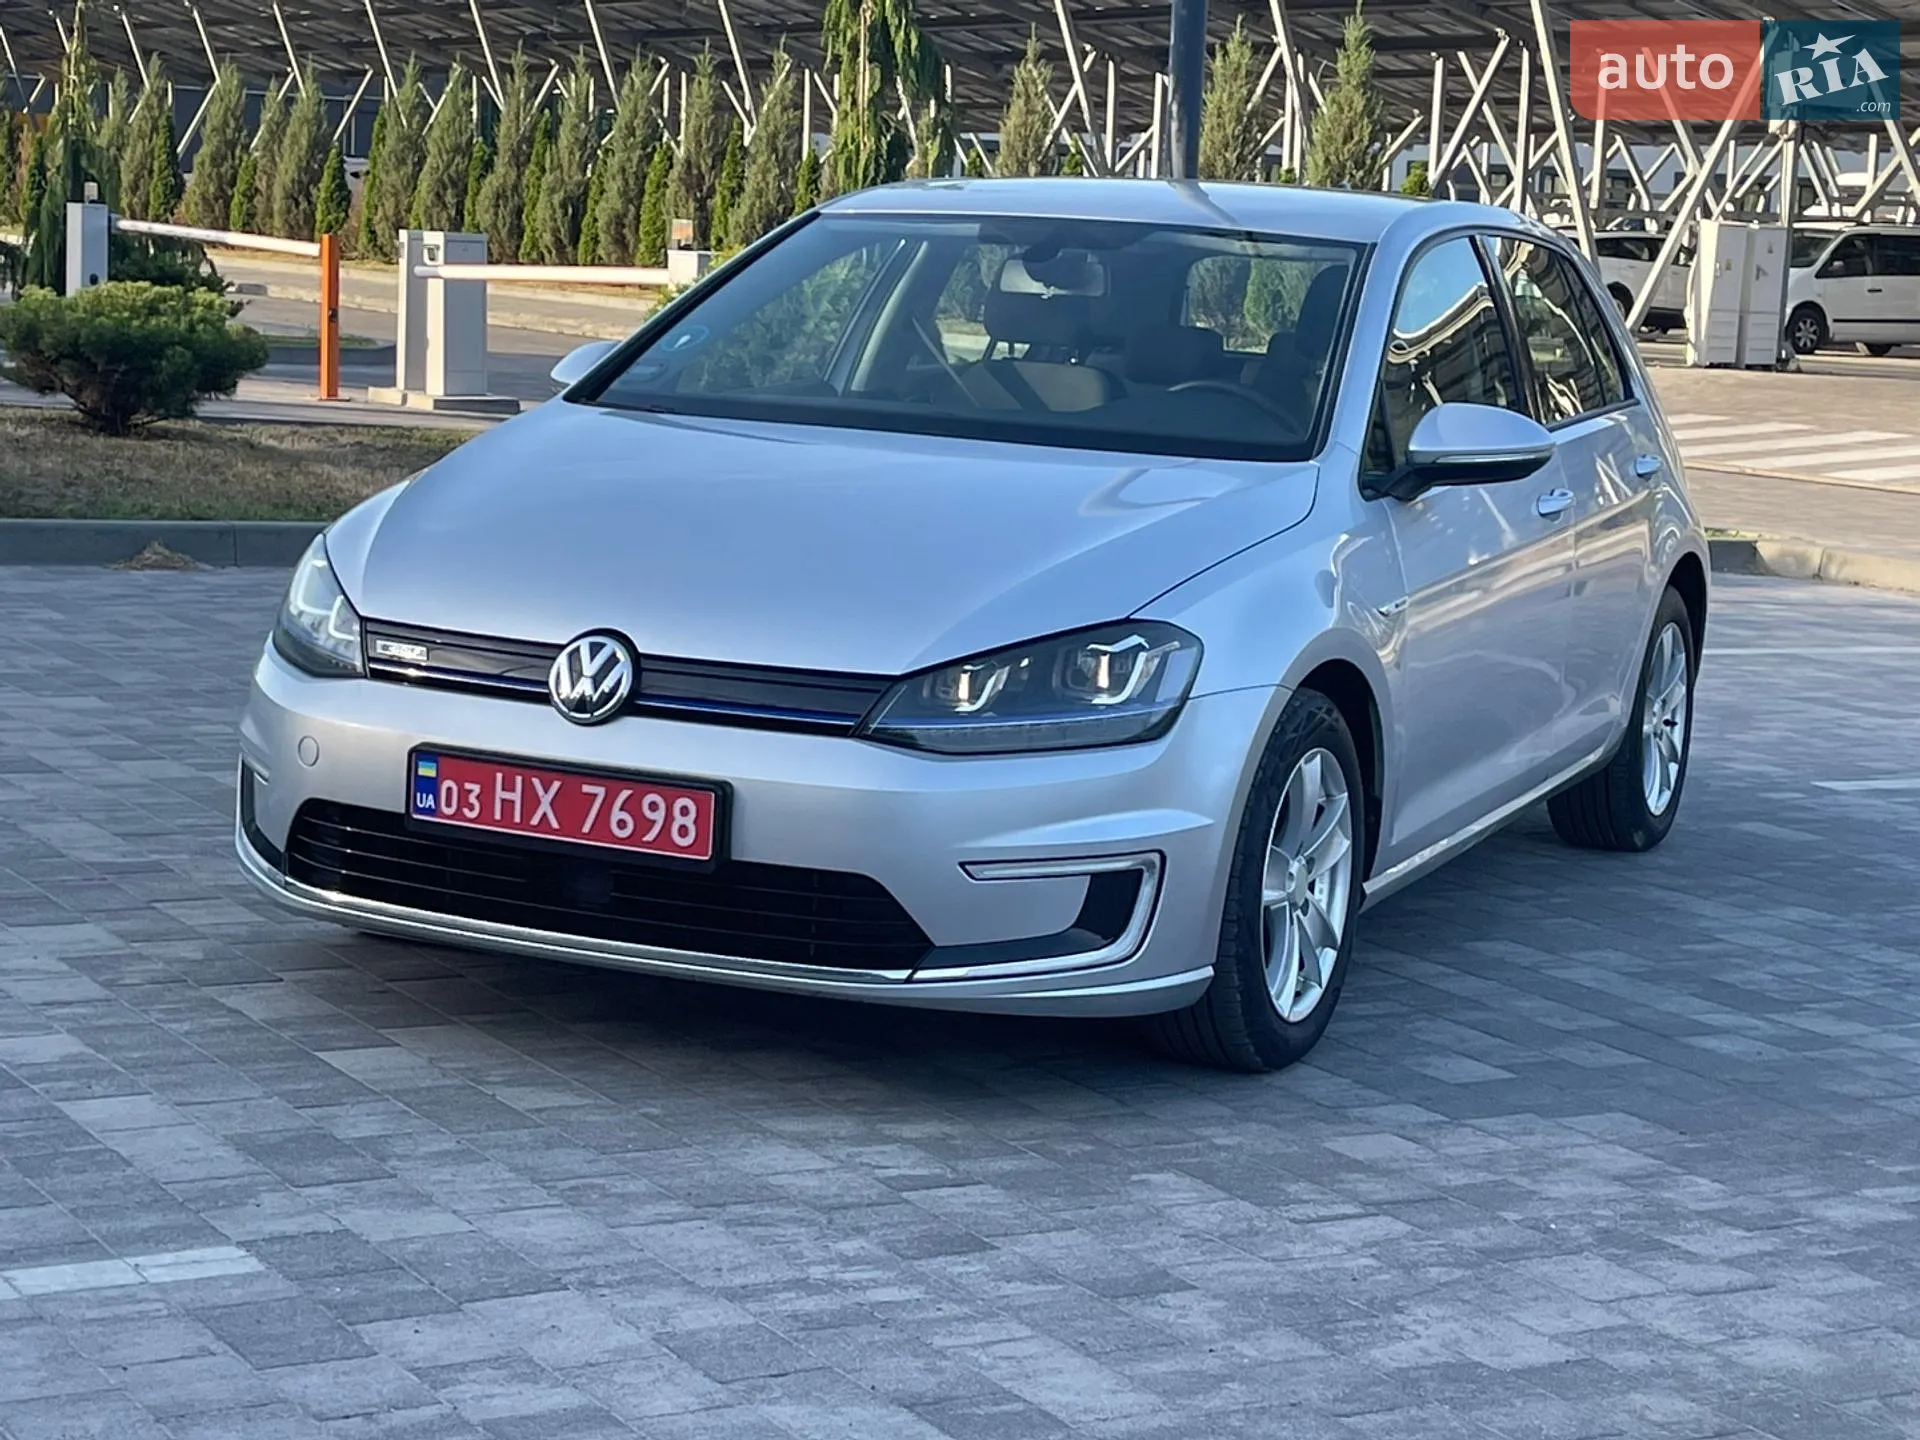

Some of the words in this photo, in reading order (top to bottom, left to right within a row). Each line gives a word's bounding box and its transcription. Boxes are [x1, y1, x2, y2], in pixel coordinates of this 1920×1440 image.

[416, 792, 436, 810] UA
[440, 779, 482, 820] 03
[493, 772, 562, 829] HX
[581, 784, 697, 847] 7698
